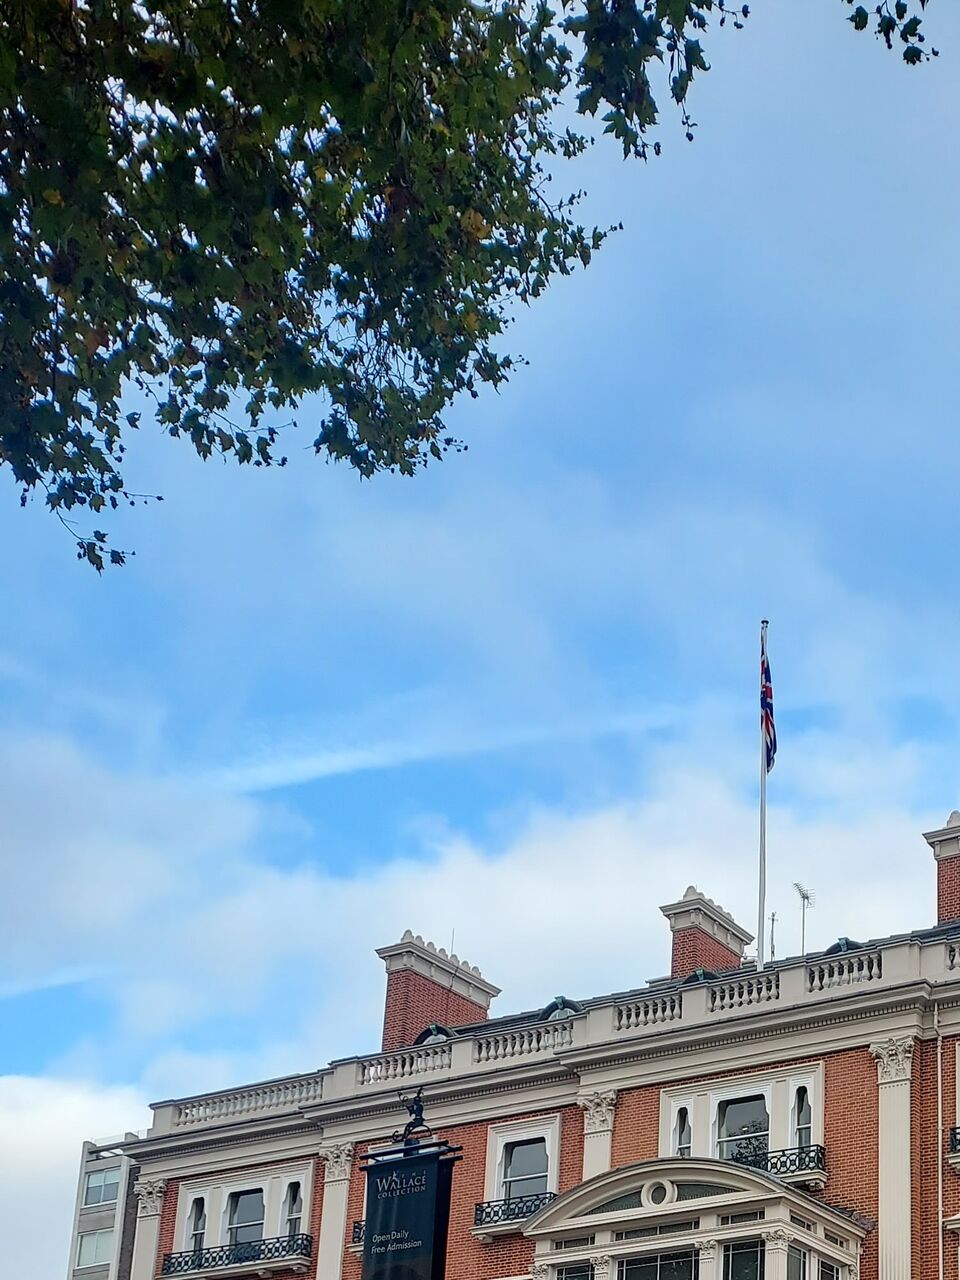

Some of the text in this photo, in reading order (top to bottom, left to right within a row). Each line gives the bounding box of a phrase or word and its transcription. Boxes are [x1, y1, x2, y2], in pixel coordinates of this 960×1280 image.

[376, 1175, 426, 1192] WALLACE
[377, 1185, 426, 1199] COLLECTION
[372, 1230, 409, 1243] Open Daily
[371, 1240, 422, 1254] Free Admission
